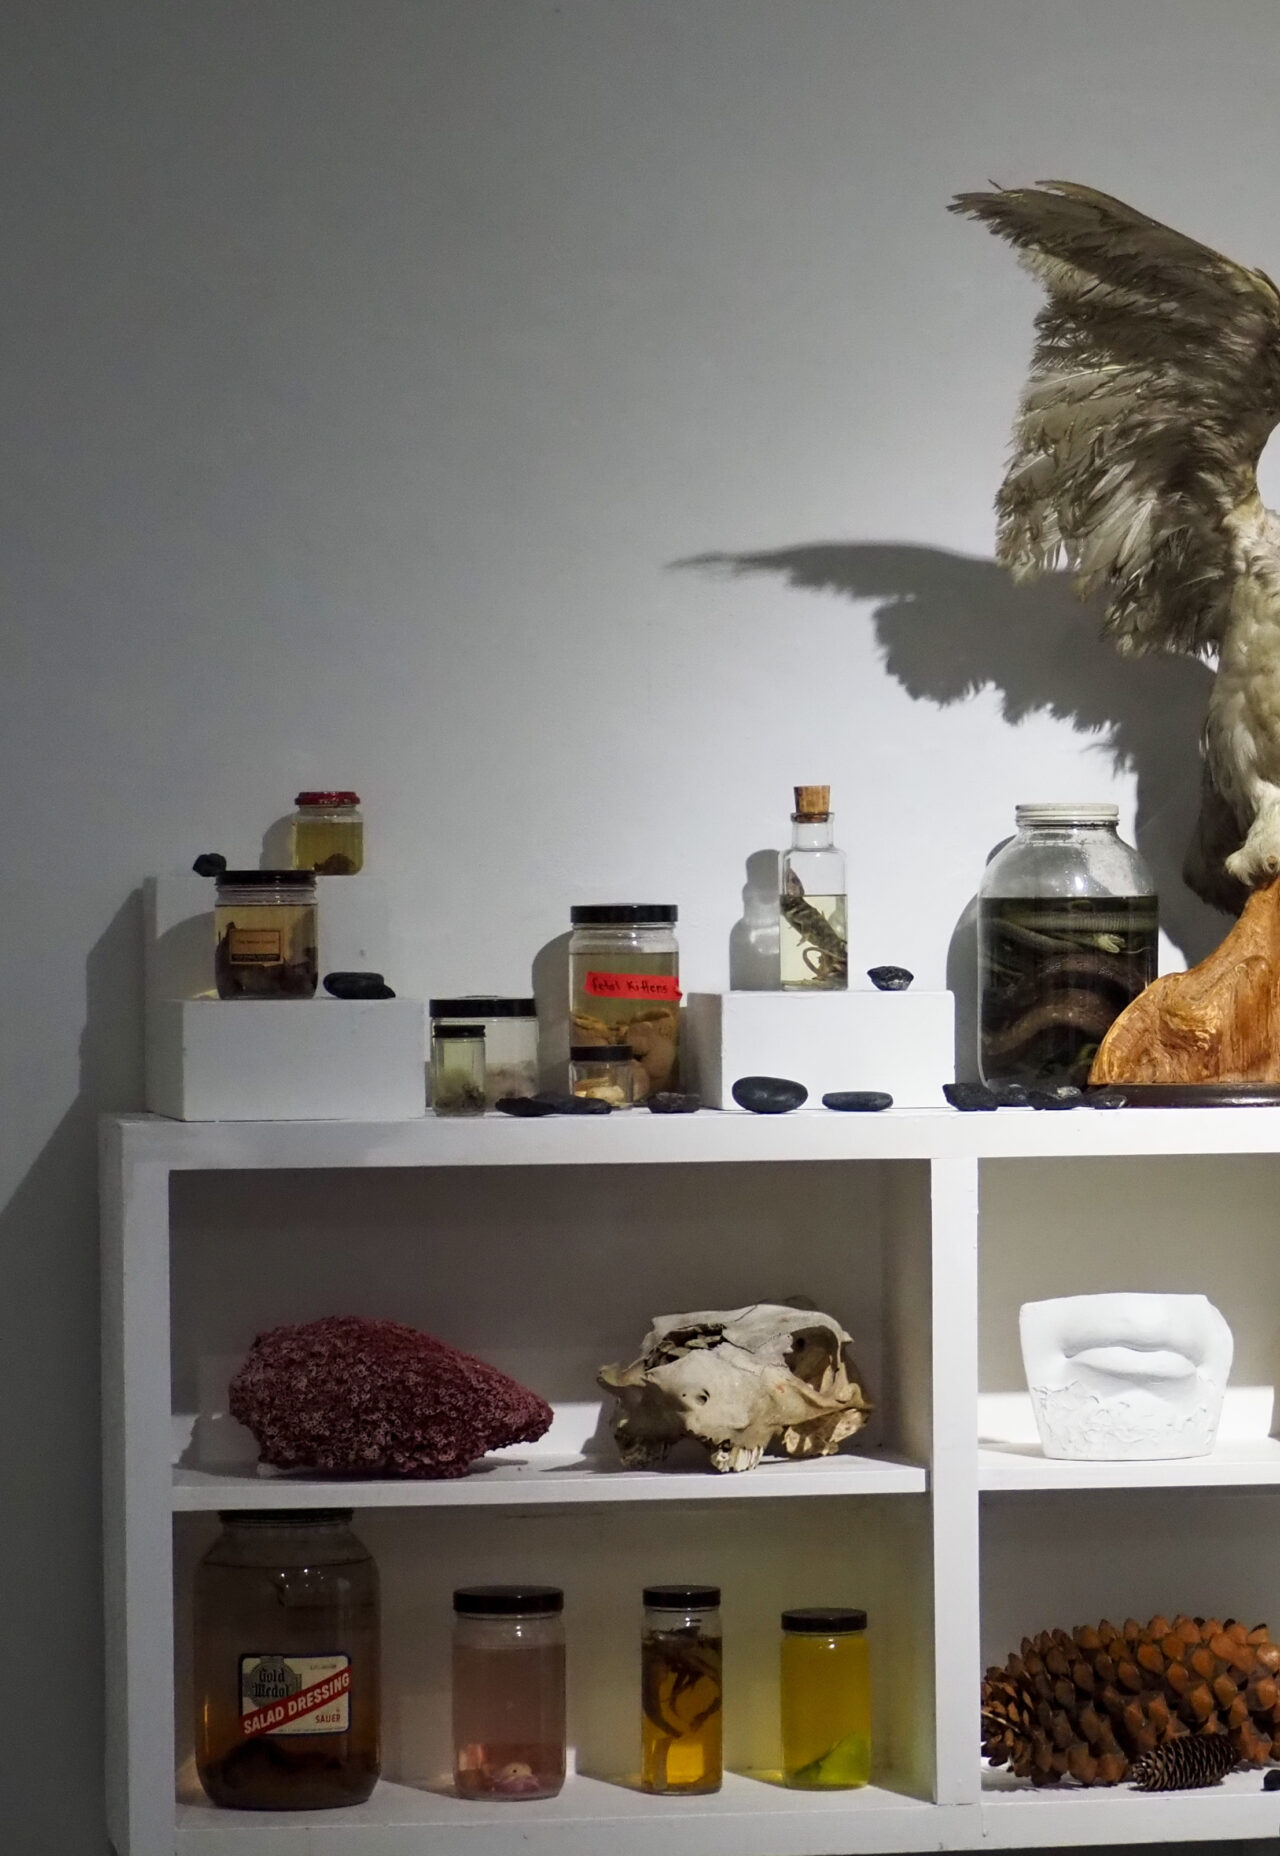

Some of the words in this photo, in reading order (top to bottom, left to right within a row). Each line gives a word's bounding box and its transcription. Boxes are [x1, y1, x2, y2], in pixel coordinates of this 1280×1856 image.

[258, 1667, 285, 1683] Gold
[243, 1706, 285, 1734] SALAD
[287, 1672, 350, 1716] DRESSING
[315, 1713, 341, 1724] SAUER
